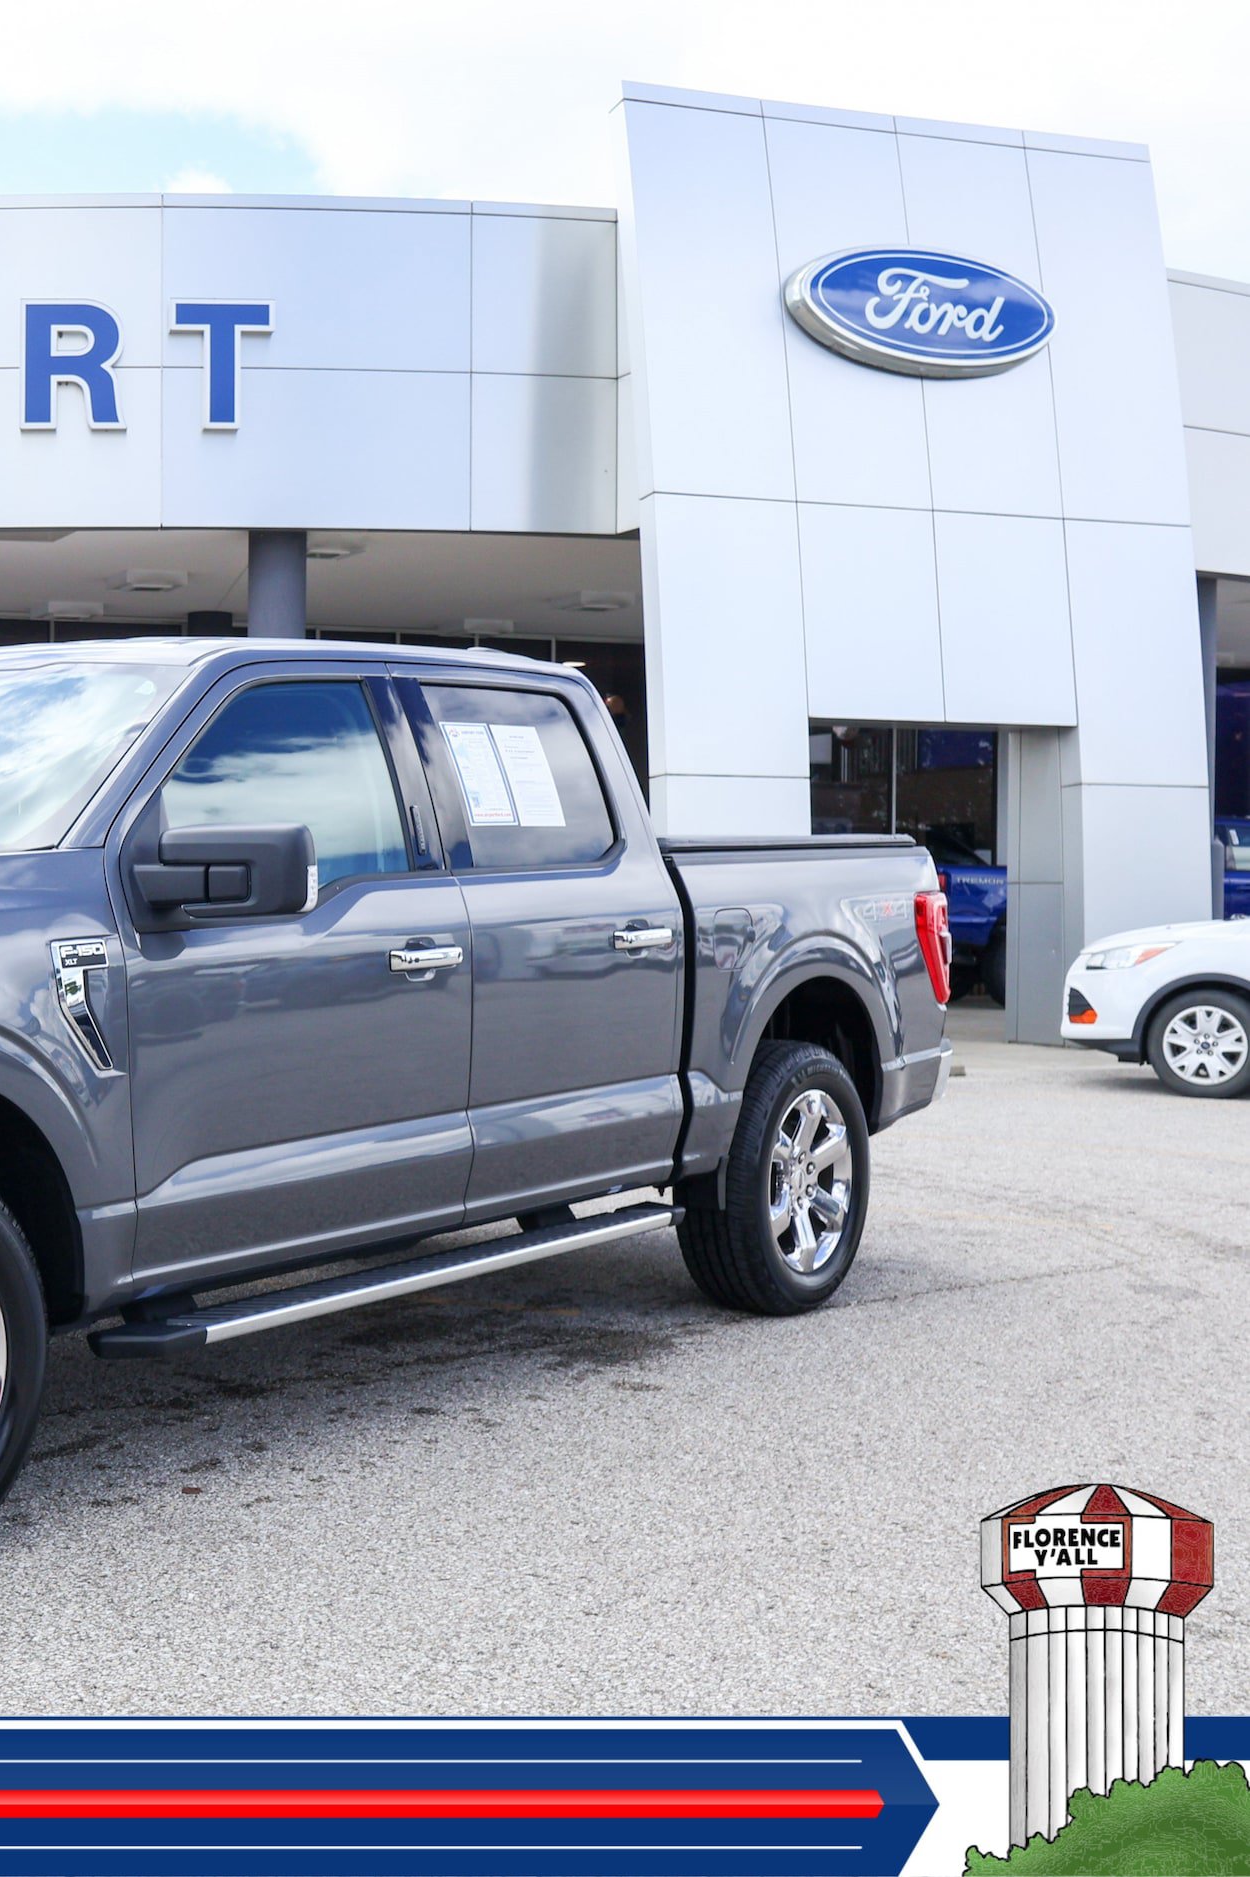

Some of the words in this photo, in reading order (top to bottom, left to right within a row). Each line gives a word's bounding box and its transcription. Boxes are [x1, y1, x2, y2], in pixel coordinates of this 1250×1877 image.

[864, 266, 1004, 343] Ford
[60, 943, 104, 958] F-150
[65, 957, 78, 966] XLT
